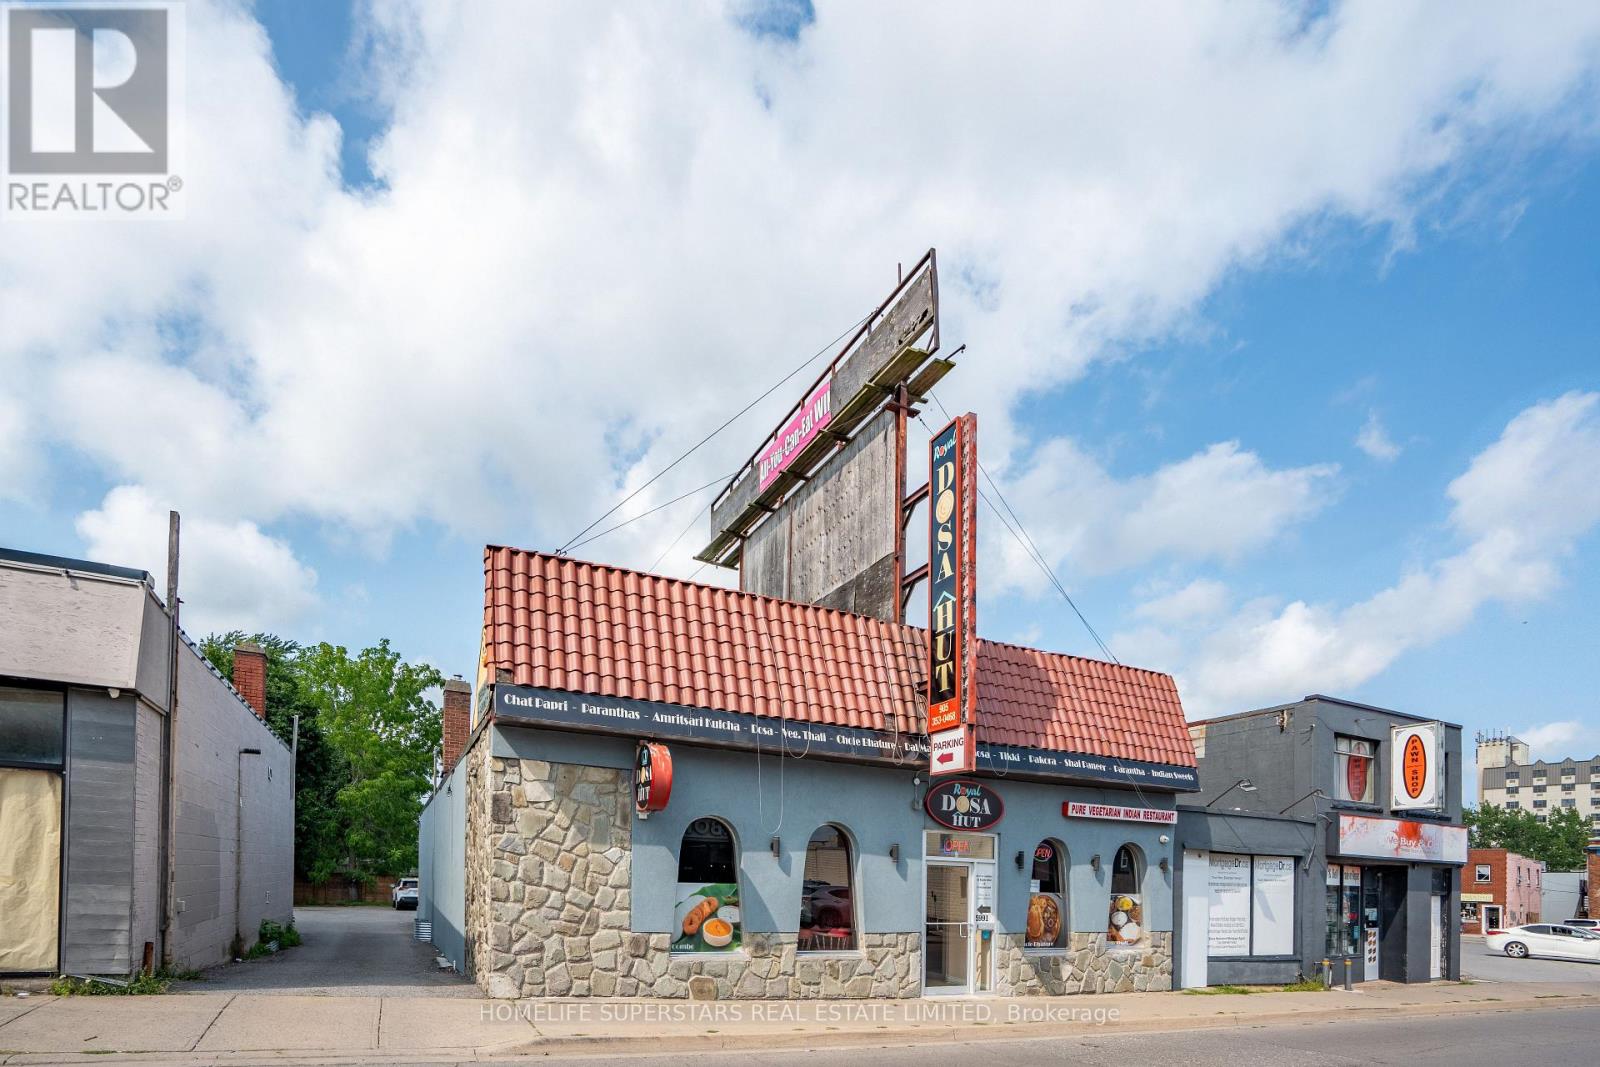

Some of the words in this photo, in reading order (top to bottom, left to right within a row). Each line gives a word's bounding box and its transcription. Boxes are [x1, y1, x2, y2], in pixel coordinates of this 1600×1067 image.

[934, 429, 956, 462] Royal
[935, 461, 955, 584] DOSA
[935, 599, 955, 693] HUT
[504, 693, 535, 708] Chat
[535, 697, 568, 711] Papri
[581, 703, 641, 720] Paranthas
[652, 711, 703, 727] Amritsari
[705, 718, 740, 732] Kulcha
[801, 730, 826, 742] Thali
[836, 734, 861, 746] Chole
[861, 737, 896, 750] Bhature
[904, 742, 919, 752] Dal
[1000, 751, 1020, 761] Tikki
[1028, 754, 1057, 765] Pakora
[1081, 760, 1107, 772] Paneer
[1113, 765, 1146, 776] Parantha
[1151, 769, 1173, 779] Indian
[1173, 771, 1194, 781] Sweets
[933, 737, 964, 752] PARKING
[1410, 739, 1419, 763] PAWN
[953, 783, 982, 798] Royal
[1411, 769, 1419, 793] SHOP
[941, 794, 992, 815] DOSA
[1072, 804, 1086, 815] PURE
[1089, 806, 1120, 818] VEGETARIAN
[1123, 808, 1141, 819] INDIAN
[1143, 810, 1175, 822] RESTAURANT
[952, 814, 981, 828] HUT
[1035, 847, 1051, 858] PEN
